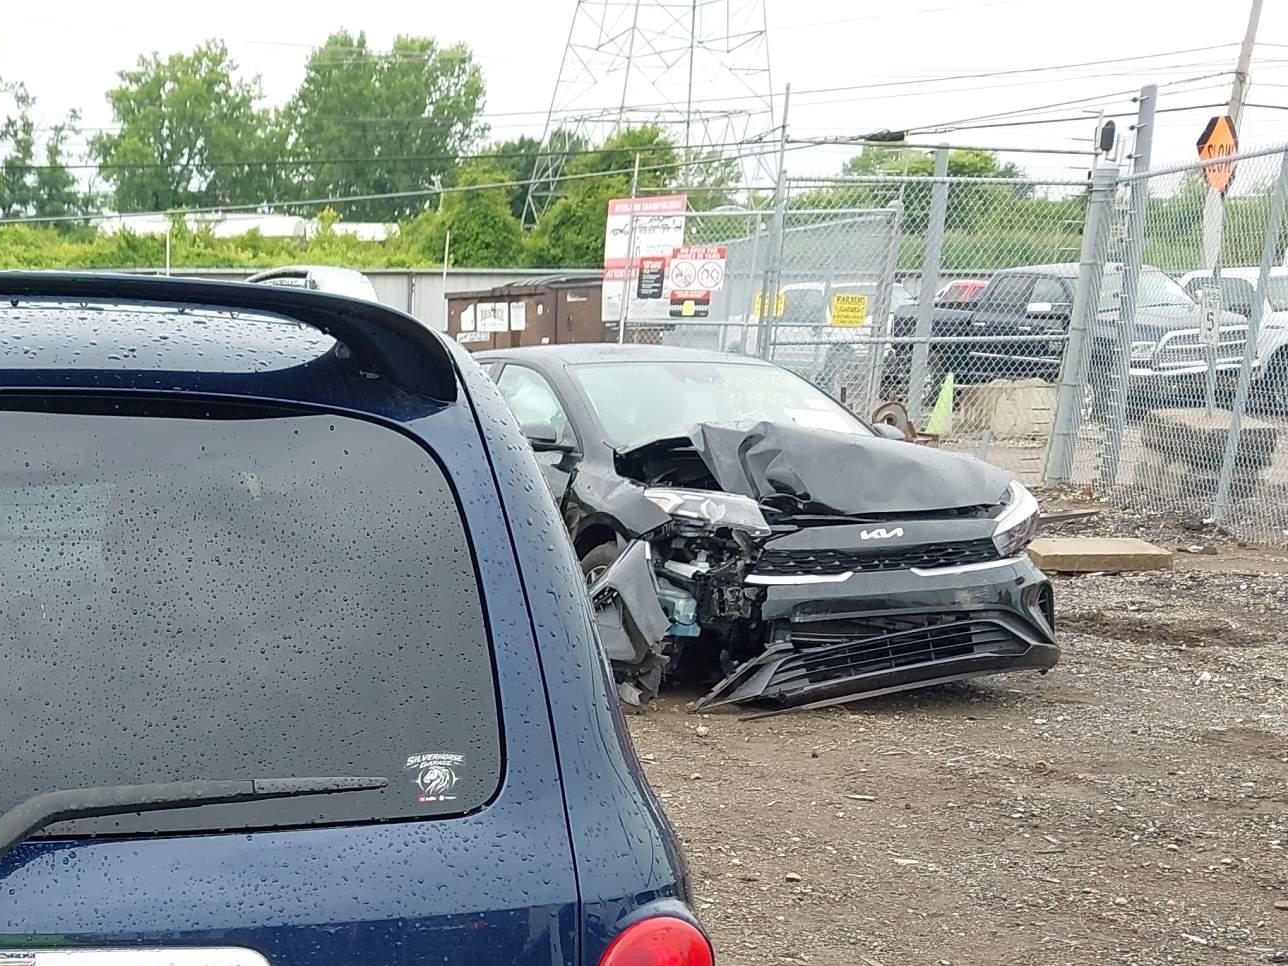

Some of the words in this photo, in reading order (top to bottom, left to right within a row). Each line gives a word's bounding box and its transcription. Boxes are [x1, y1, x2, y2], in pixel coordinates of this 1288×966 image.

[1207, 144, 1235, 173] SLOW
[1206, 311, 1214, 332] 5
[406, 753, 463, 766] SILVERHORSE
